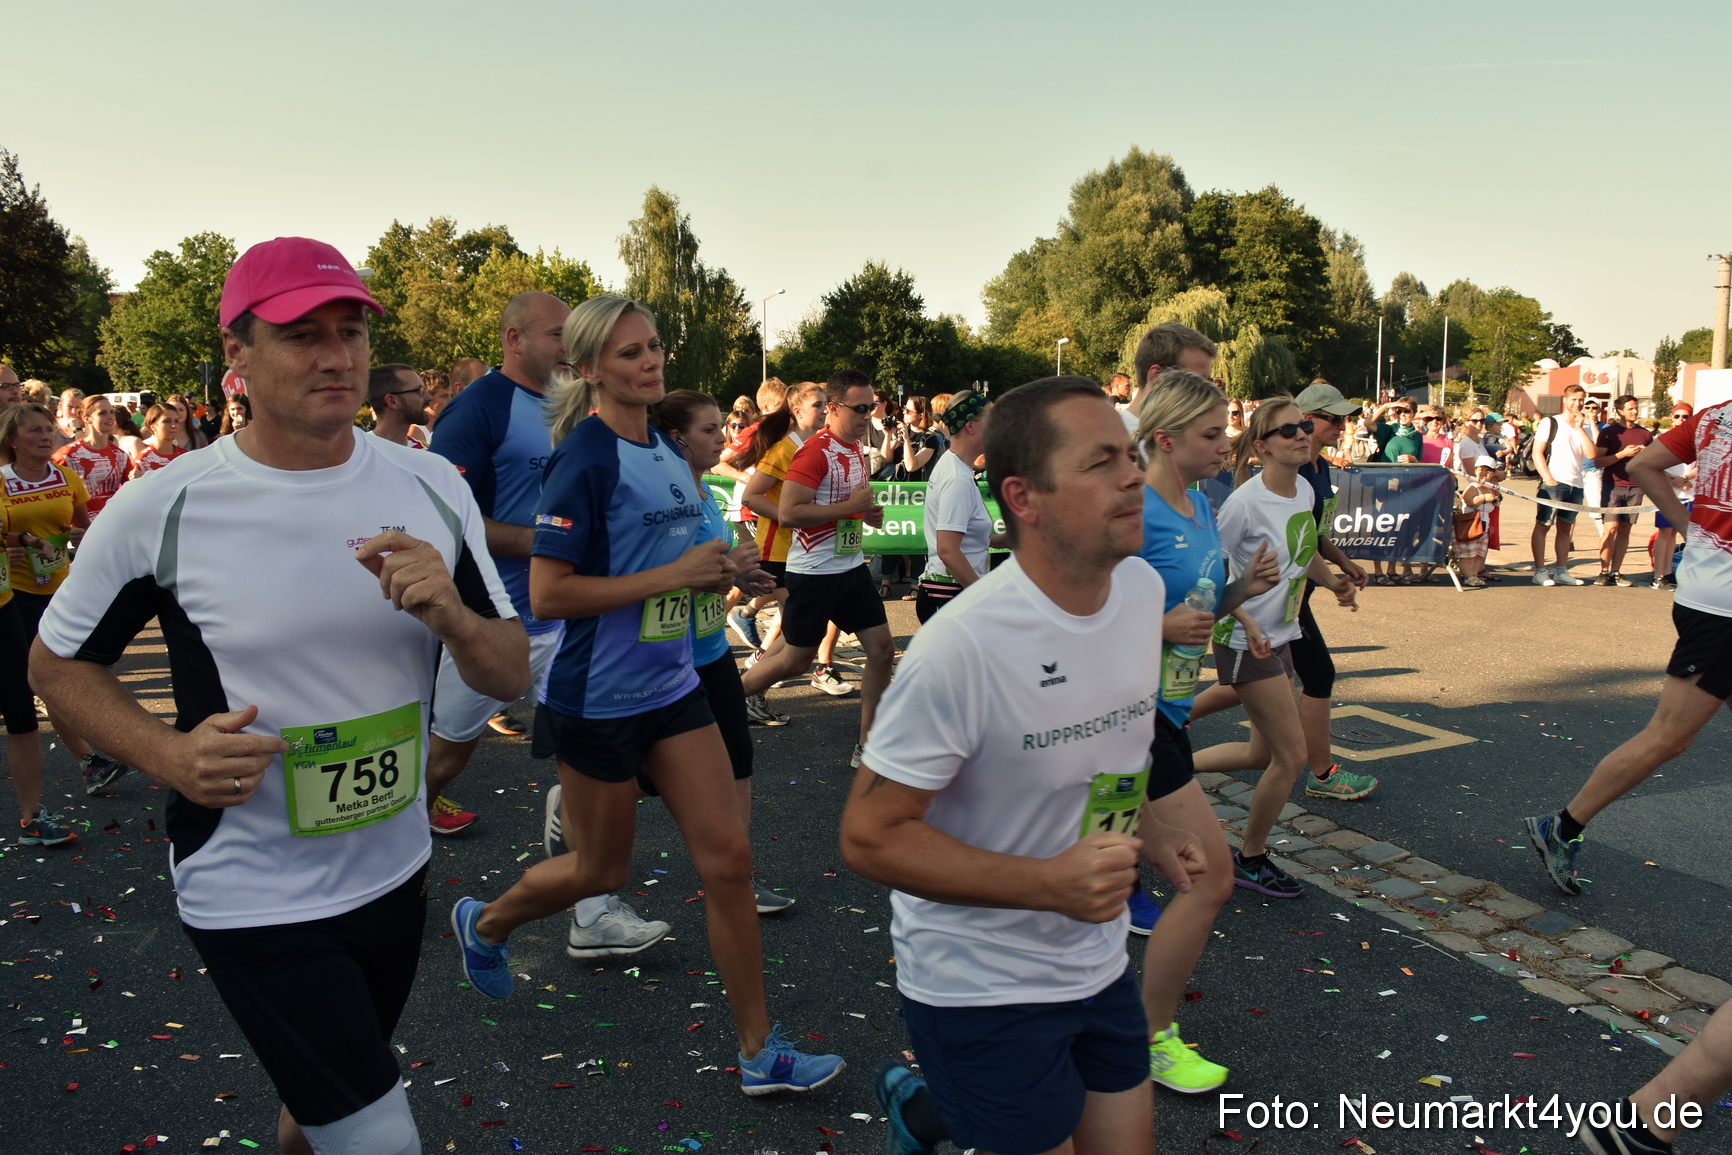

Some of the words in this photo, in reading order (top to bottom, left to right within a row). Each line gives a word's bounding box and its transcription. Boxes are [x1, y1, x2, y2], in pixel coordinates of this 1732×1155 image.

[11, 493, 42, 505] MAX
[45, 490, 72, 500] BÖGL
[304, 736, 357, 754] firmenlauf
[320, 749, 400, 803] 758
[336, 801, 369, 814] Metka
[371, 789, 394, 805] Bertl
[315, 812, 365, 827] guttenberger
[367, 803, 390, 817] partner
